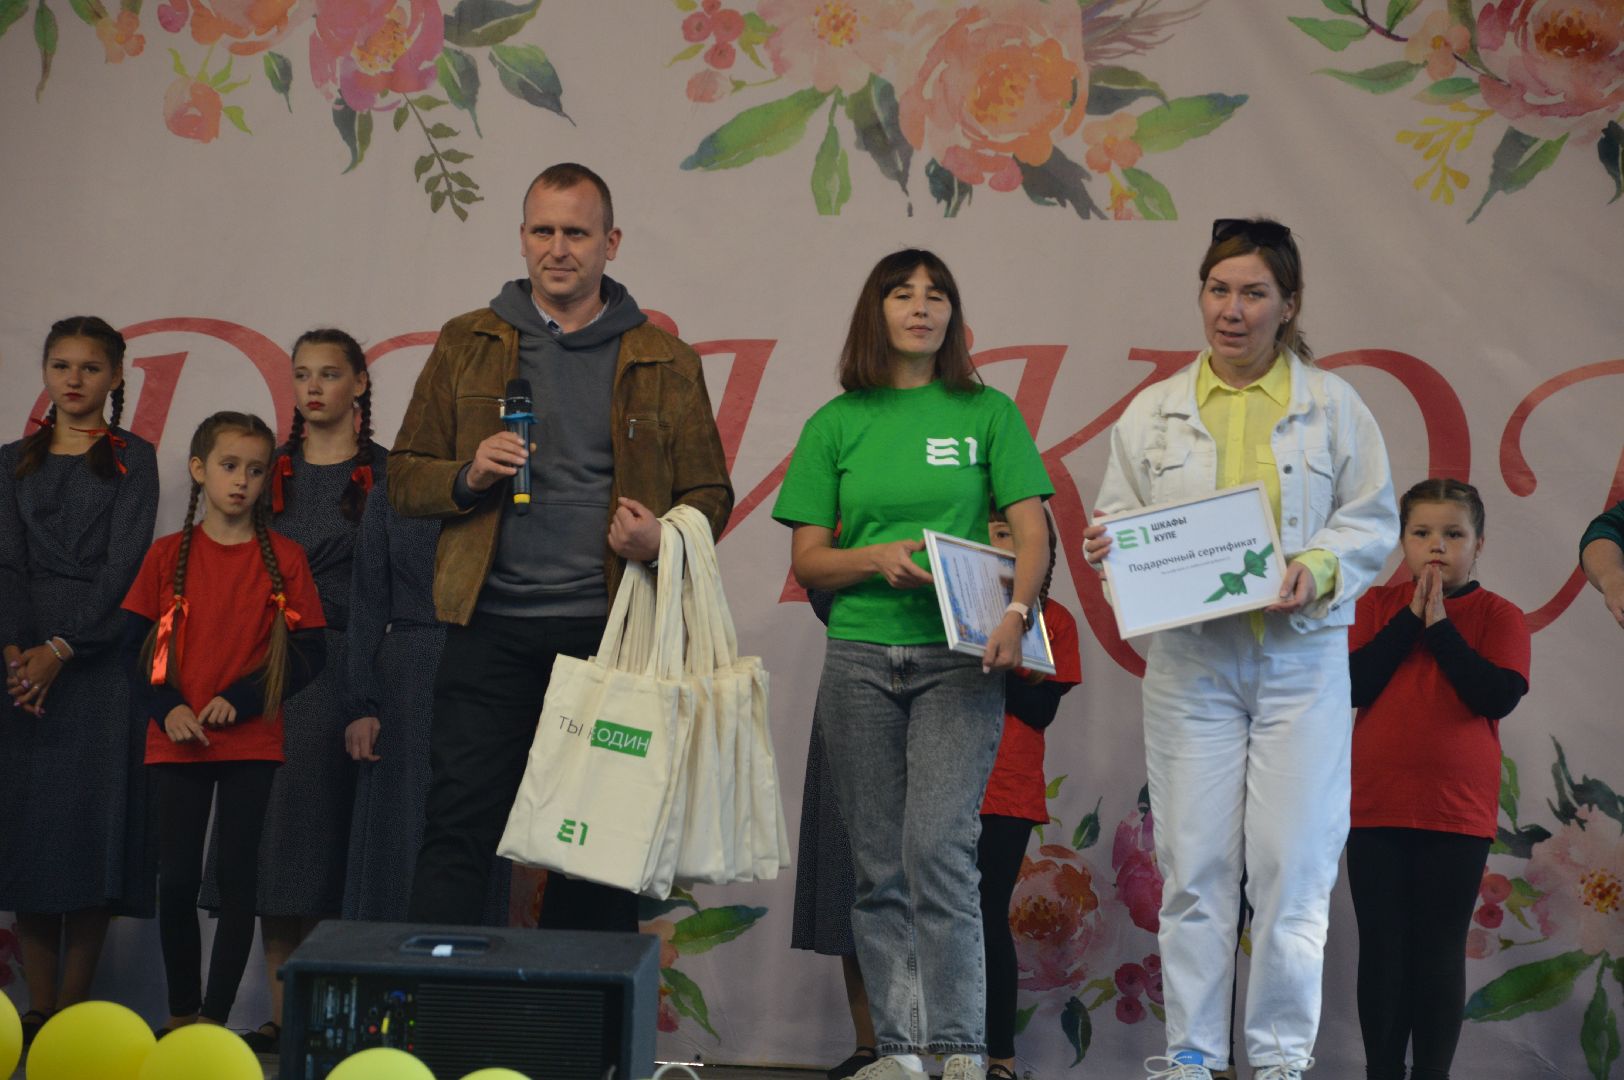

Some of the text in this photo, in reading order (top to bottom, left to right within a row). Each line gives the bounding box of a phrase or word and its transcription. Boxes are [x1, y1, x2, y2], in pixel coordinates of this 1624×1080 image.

[926, 437, 978, 466] E1
[1151, 516, 1187, 531] ШКАФЫ
[1116, 525, 1151, 550] E1
[1153, 530, 1177, 543] КУПЕ
[1128, 549, 1196, 573] Подарочный
[1198, 537, 1257, 558] сертификат
[559, 715, 584, 737] ТЫ
[556, 818, 589, 846] E1
